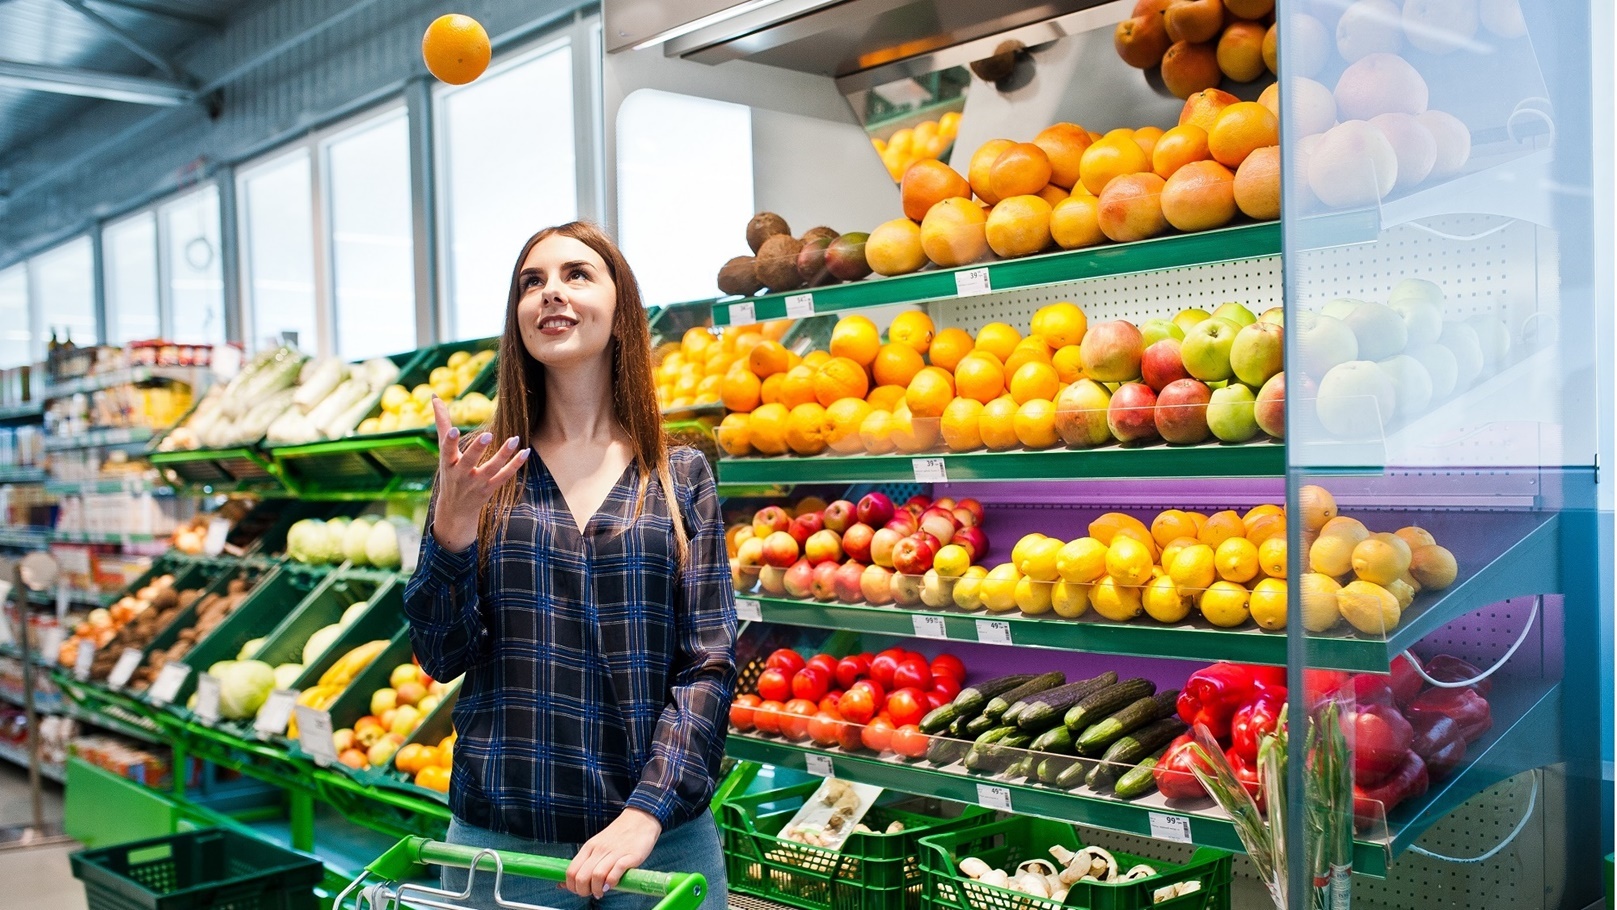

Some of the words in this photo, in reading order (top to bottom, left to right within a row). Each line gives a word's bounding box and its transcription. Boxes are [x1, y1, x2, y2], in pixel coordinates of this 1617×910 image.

[970, 272, 978, 280] 39
[926, 459, 935, 467] 39
[990, 622, 999, 630] 49
[991, 787, 1000, 795] 49
[1166, 816, 1176, 825] 99
